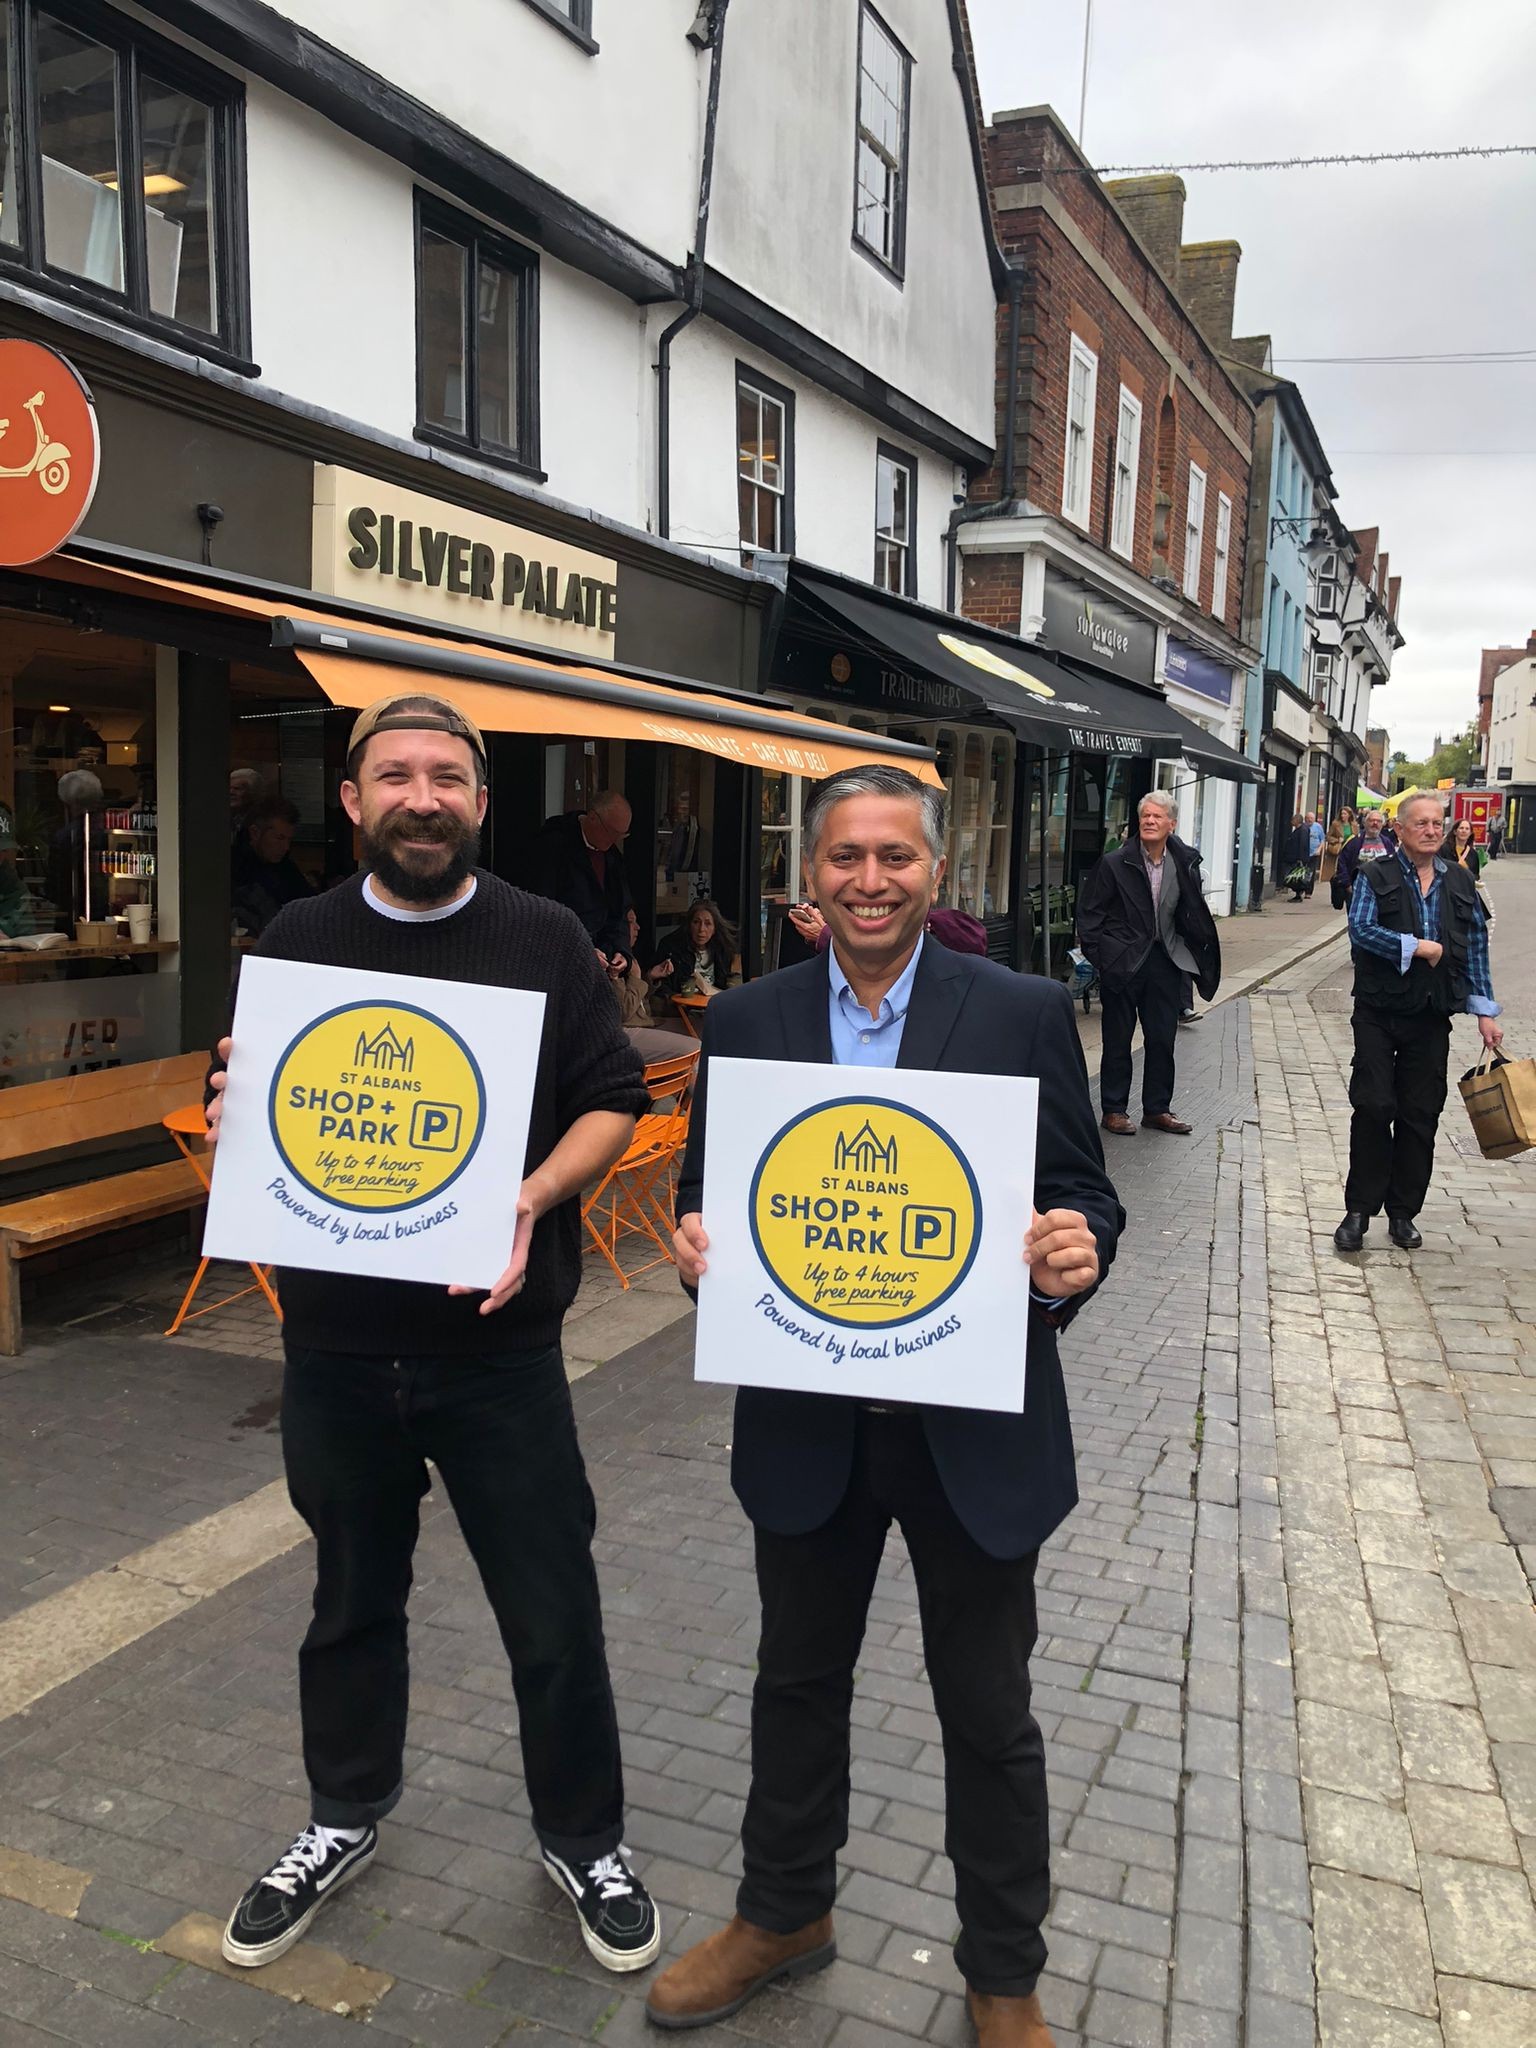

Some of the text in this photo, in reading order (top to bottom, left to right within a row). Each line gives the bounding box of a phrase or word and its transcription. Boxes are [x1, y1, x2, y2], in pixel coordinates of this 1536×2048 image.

[348, 507, 617, 632] SILVER PALATE
[881, 670, 961, 709] TRAILFINDERS
[691, 732, 745, 757] PALATE
[782, 747, 805, 769] AND
[804, 751, 829, 772] DELI
[1068, 728, 1142, 753] THE TRAVEL EXPERTS
[340, 1072, 422, 1092] ST ALBANS
[319, 1115, 399, 1146] PARK
[422, 1109, 448, 1141] P
[315, 1151, 424, 1172] Up to 4 hours
[323, 1170, 420, 1193] free parking
[821, 1177, 909, 1195] ST ALBANS
[265, 1177, 458, 1245] Powered by local business
[804, 1225, 889, 1255] PARK
[914, 1214, 942, 1249] P
[803, 1262, 919, 1285] Up to 4 hours
[813, 1284, 916, 1307] free parking
[755, 1293, 961, 1364] Powered by local business
